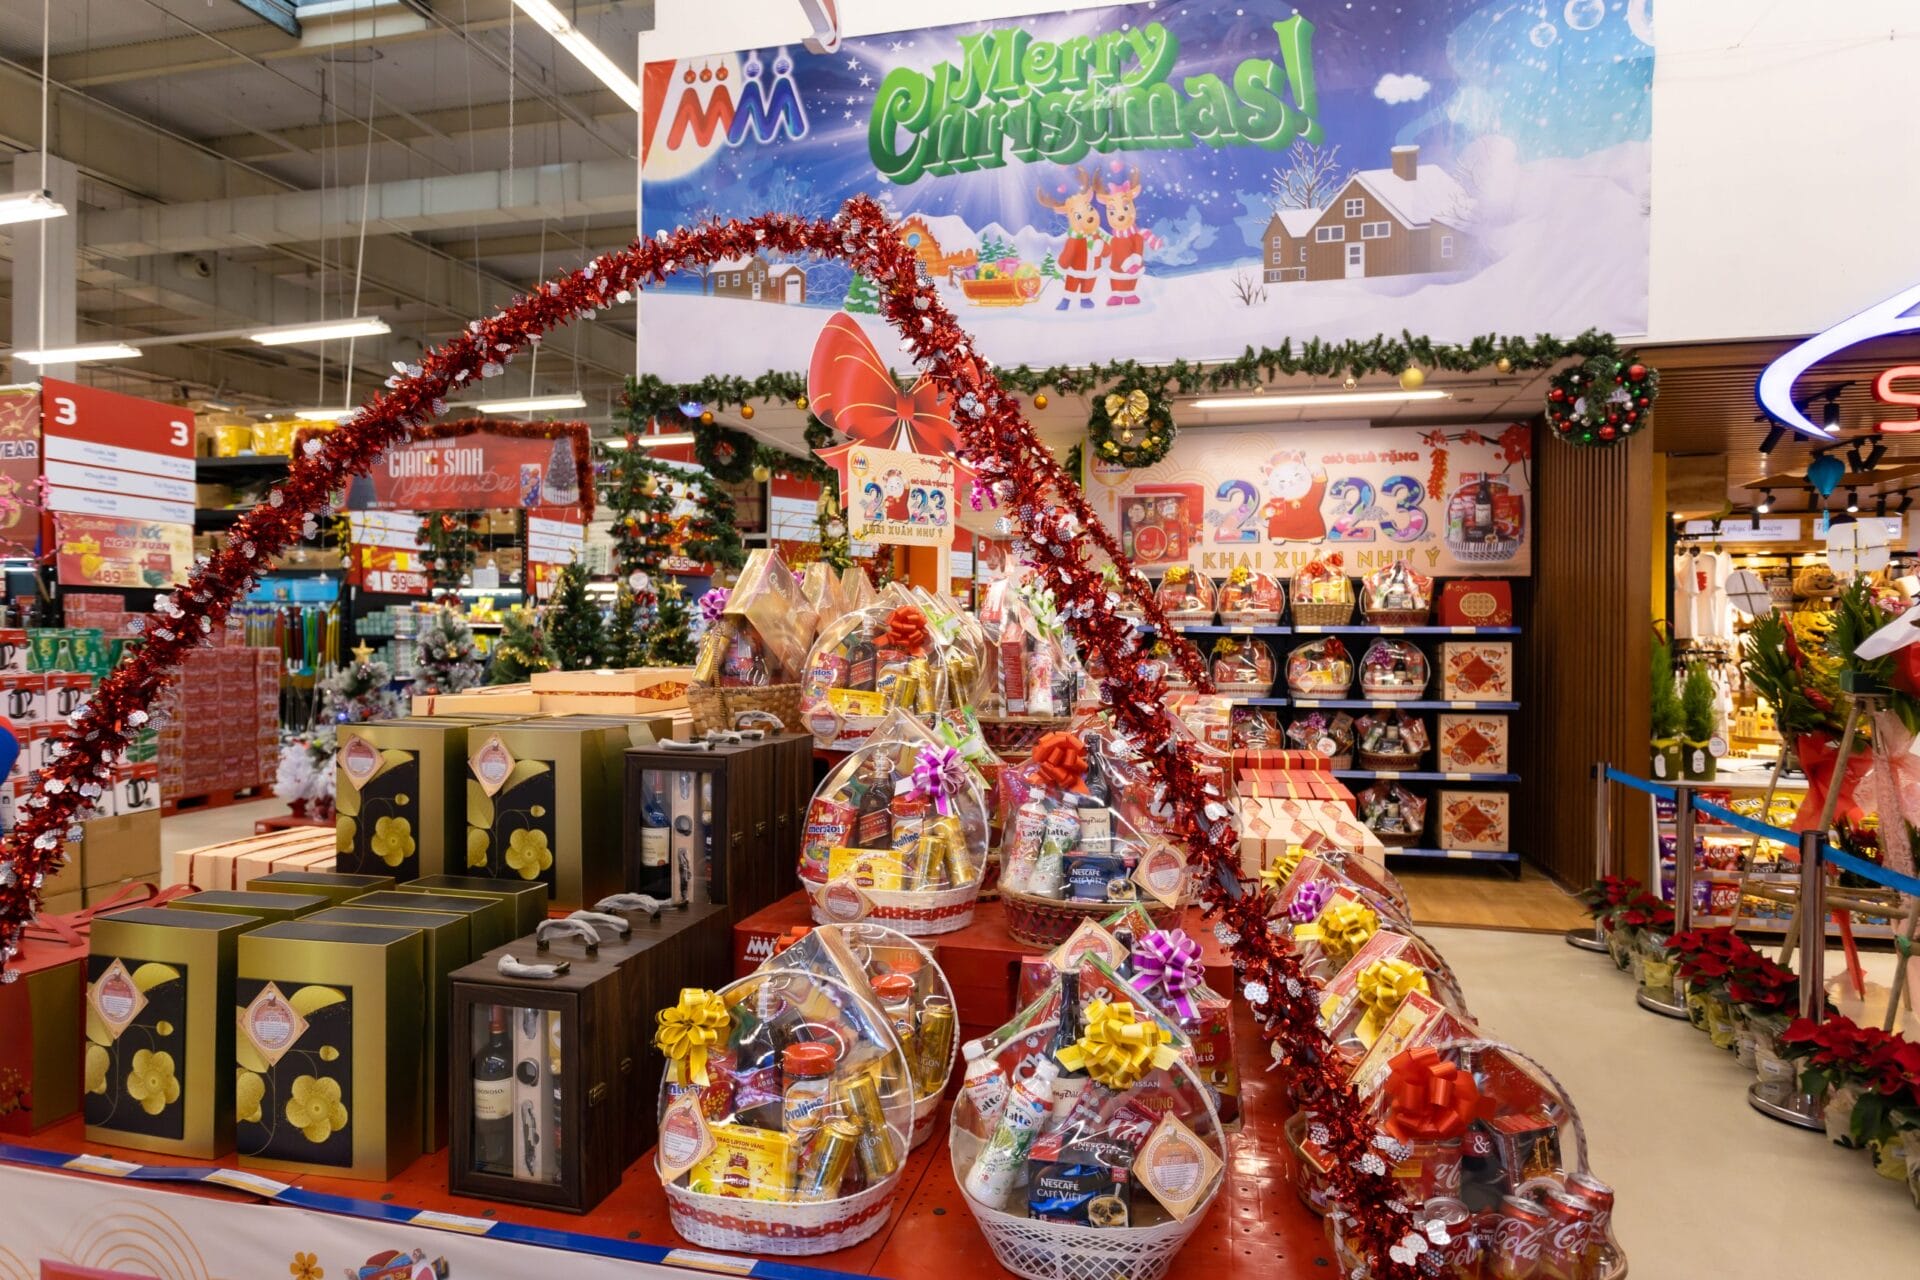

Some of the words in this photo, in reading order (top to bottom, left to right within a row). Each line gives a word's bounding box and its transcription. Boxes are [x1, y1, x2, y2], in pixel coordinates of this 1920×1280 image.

[955, 20, 1178, 104] Merry
[869, 15, 1325, 186] Christmas!
[54, 397, 77, 425] 3
[170, 421, 188, 446] 3
[444, 448, 483, 475] SINH
[1379, 449, 1419, 465] TẶNG
[1203, 551, 1261, 569] KHAI
[1274, 548, 1344, 569] XU
[1047, 829, 1070, 838] Latte
[785, 1096, 824, 1121] Ovaltine
[977, 1094, 1001, 1113] Latte
[1004, 1108, 1032, 1126] Latte
[1496, 1217, 1544, 1259] Cola
